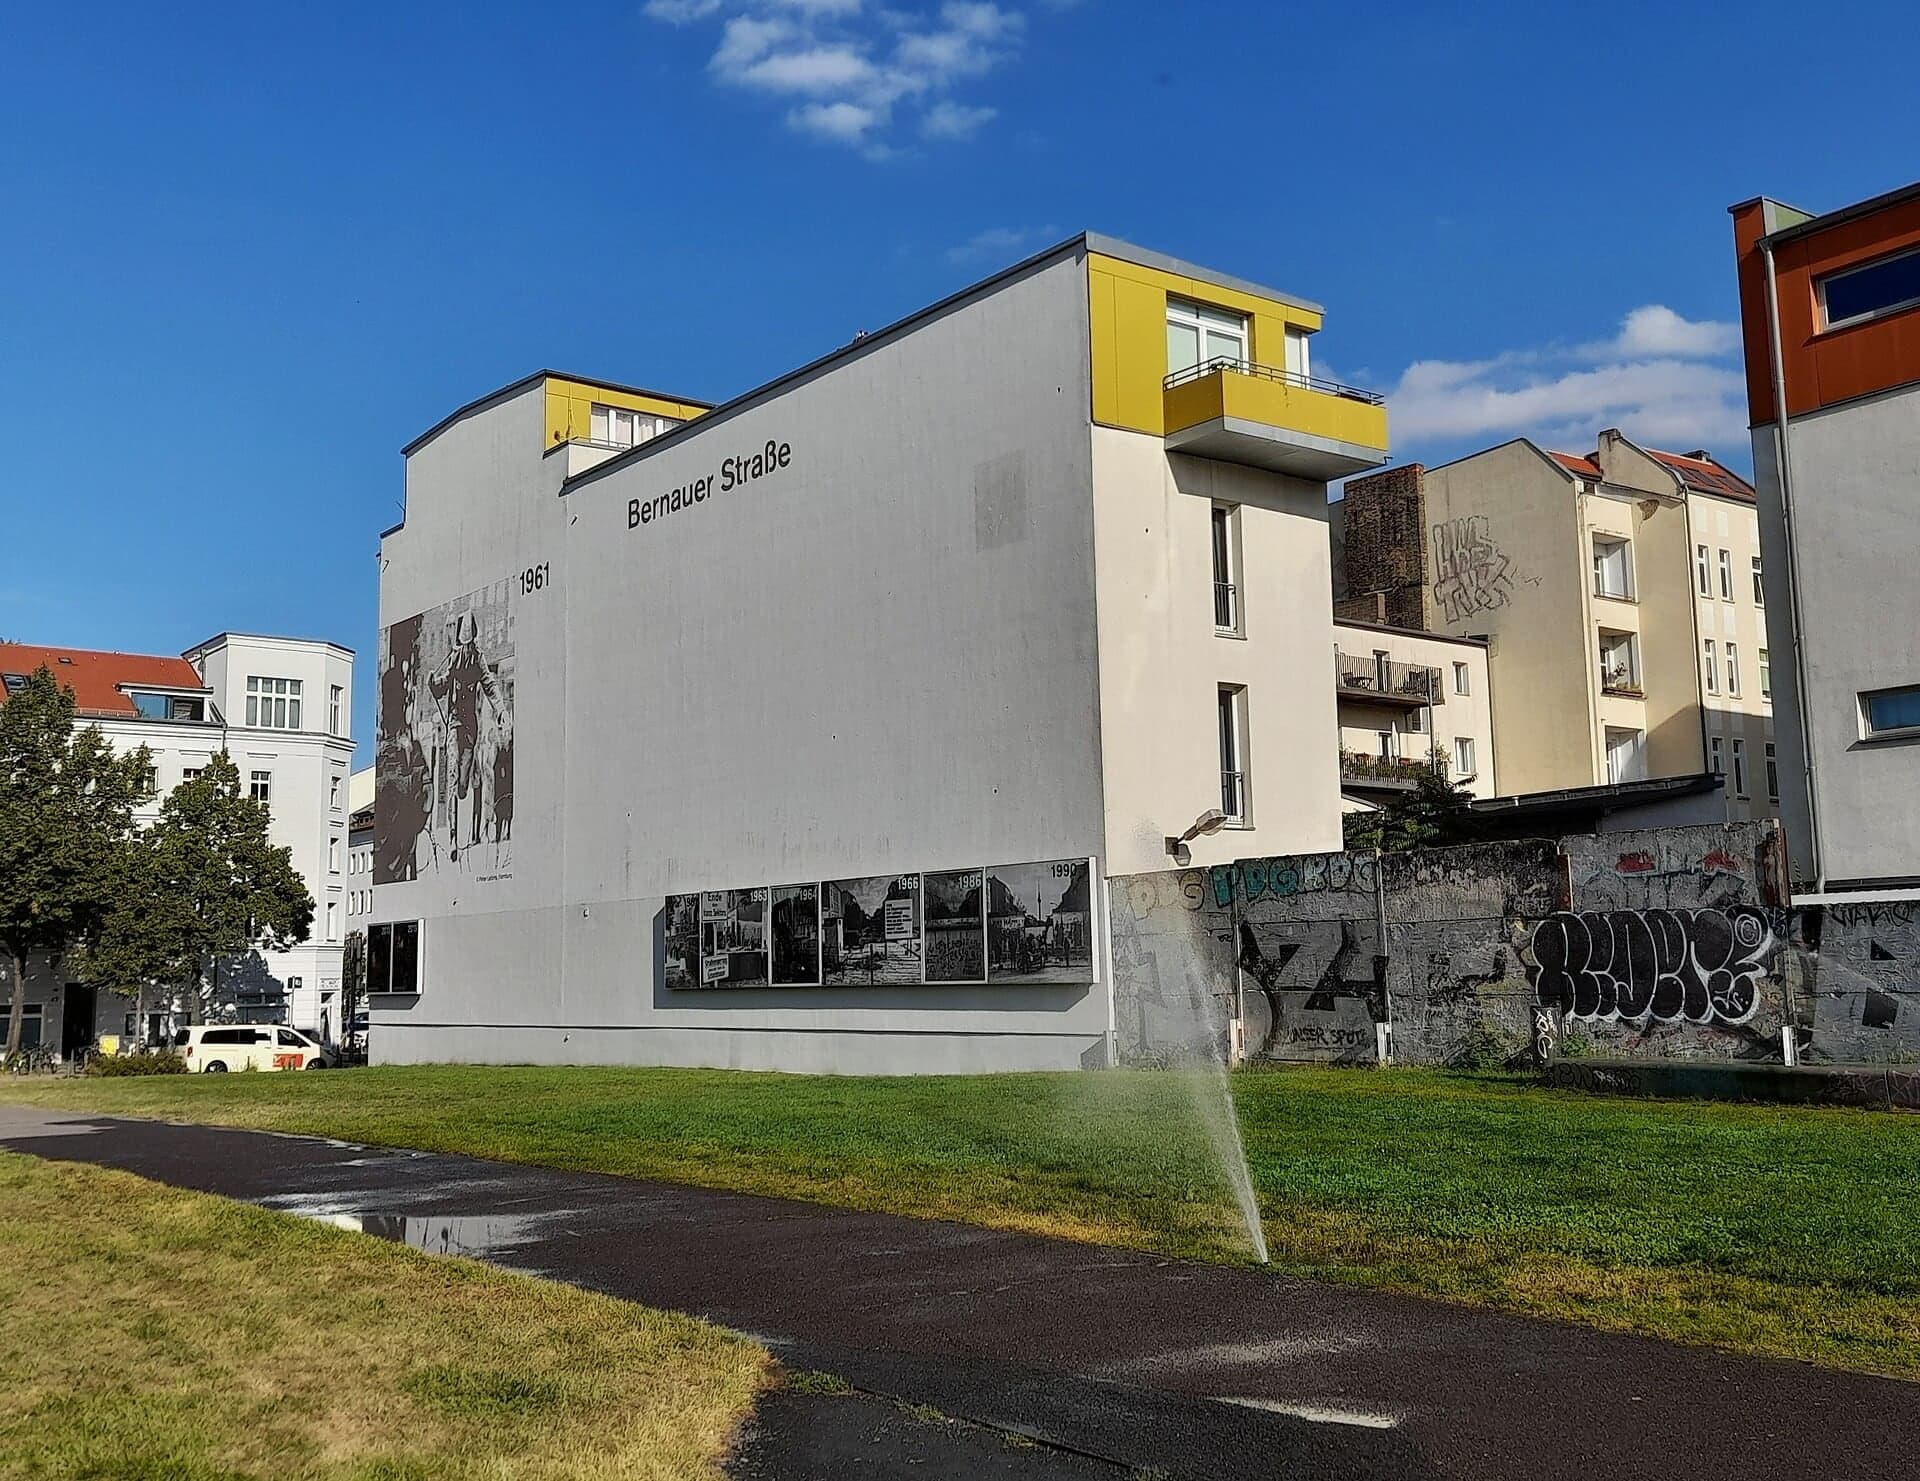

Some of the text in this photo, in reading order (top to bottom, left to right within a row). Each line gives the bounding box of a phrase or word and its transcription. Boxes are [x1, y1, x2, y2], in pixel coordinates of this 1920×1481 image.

[628, 440, 791, 529] Bernauer Straße
[520, 561, 549, 596] 1961
[1051, 863, 1077, 878] 1990
[898, 876, 919, 890] 1966
[958, 875, 982, 889] 1986
[750, 888, 768, 902] 1963
